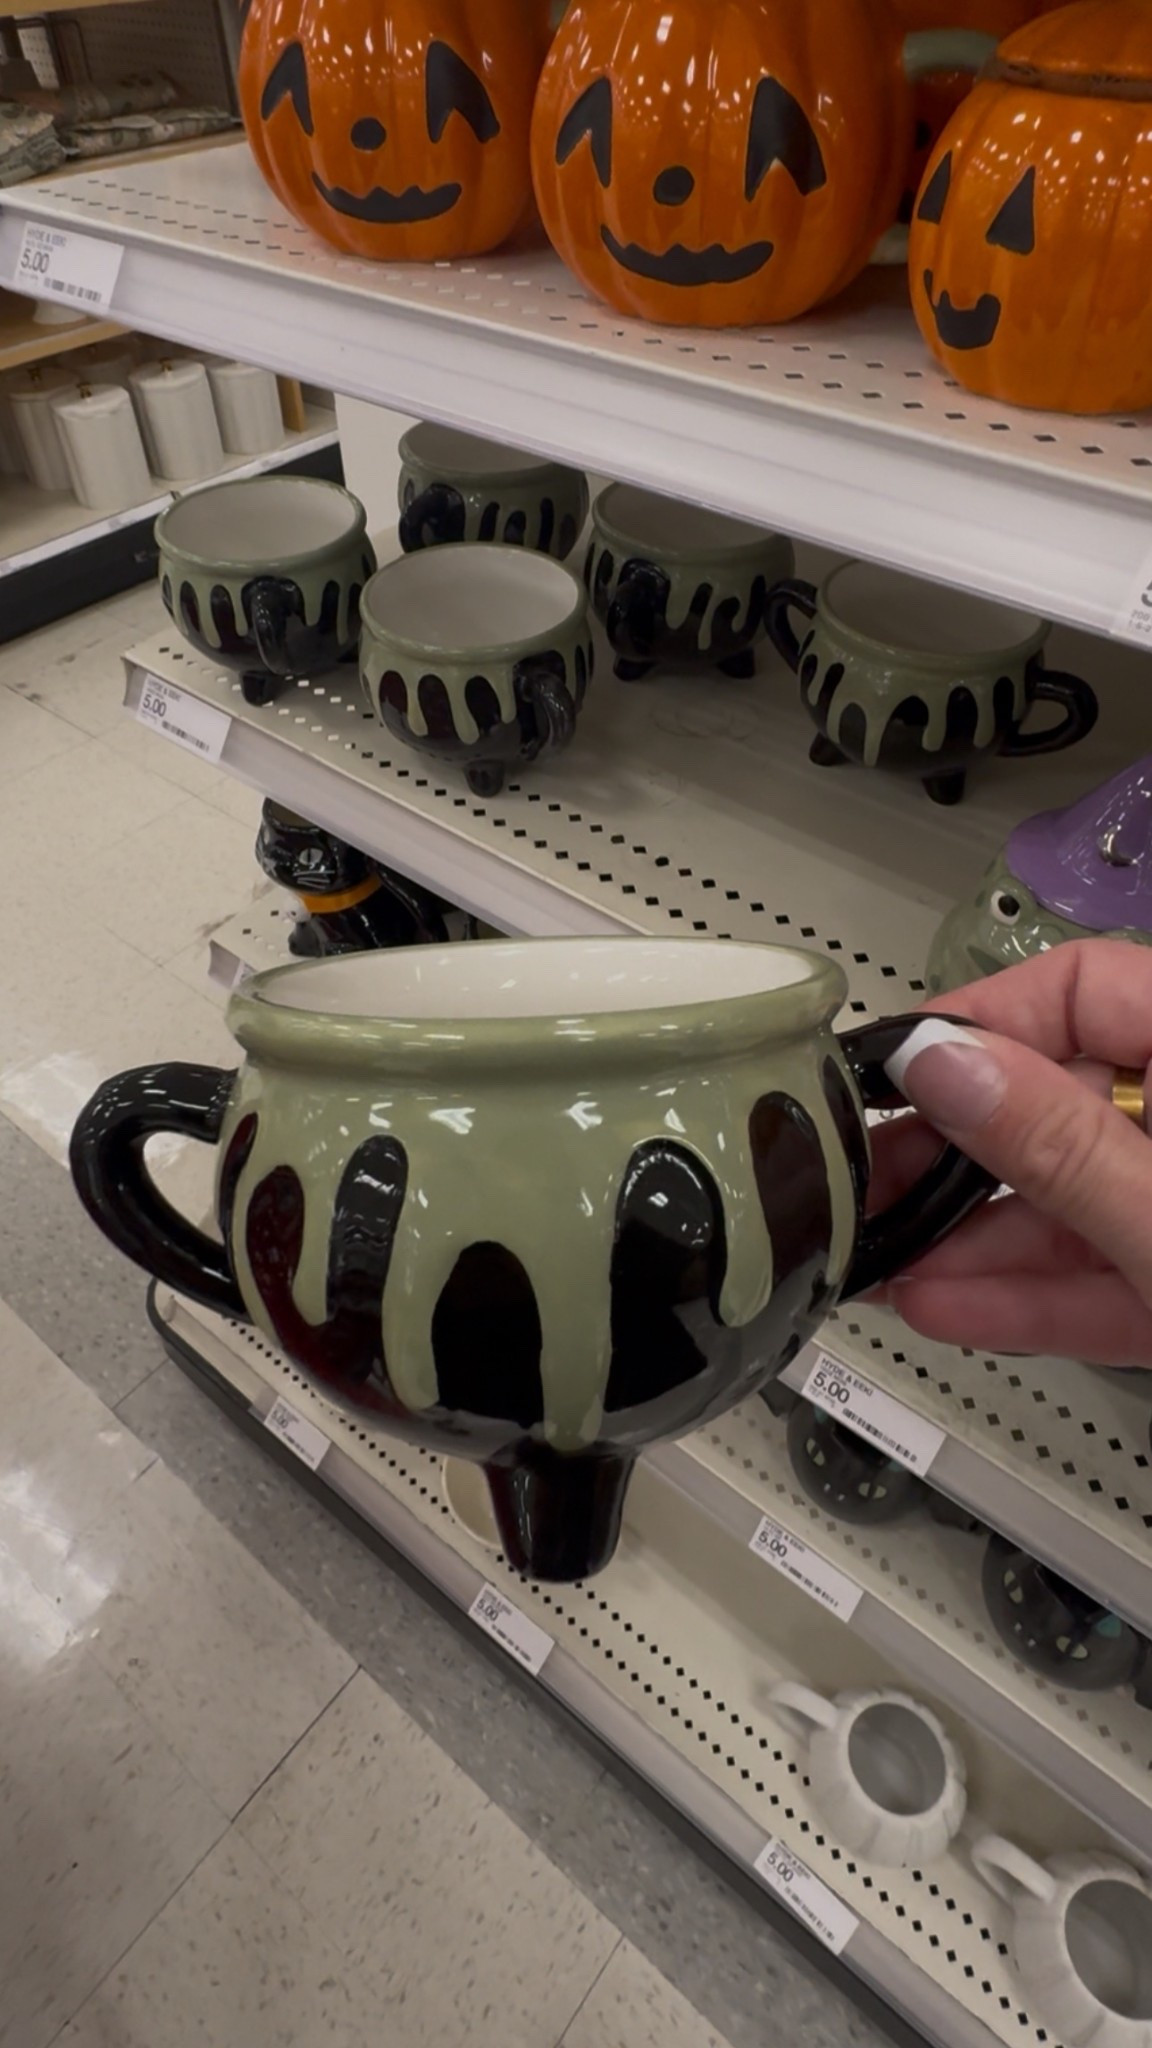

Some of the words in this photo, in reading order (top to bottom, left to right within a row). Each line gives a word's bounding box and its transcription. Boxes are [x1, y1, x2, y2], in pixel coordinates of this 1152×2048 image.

[20, 248, 50, 273] 5.00
[143, 694, 167, 717] 5.00
[822, 1358, 845, 1376] HYDE
[814, 1371, 850, 1404] 5.00
[759, 1531, 787, 1557] 5.00
[477, 1599, 499, 1622] 5.00
[767, 1852, 794, 1882] 5.00
